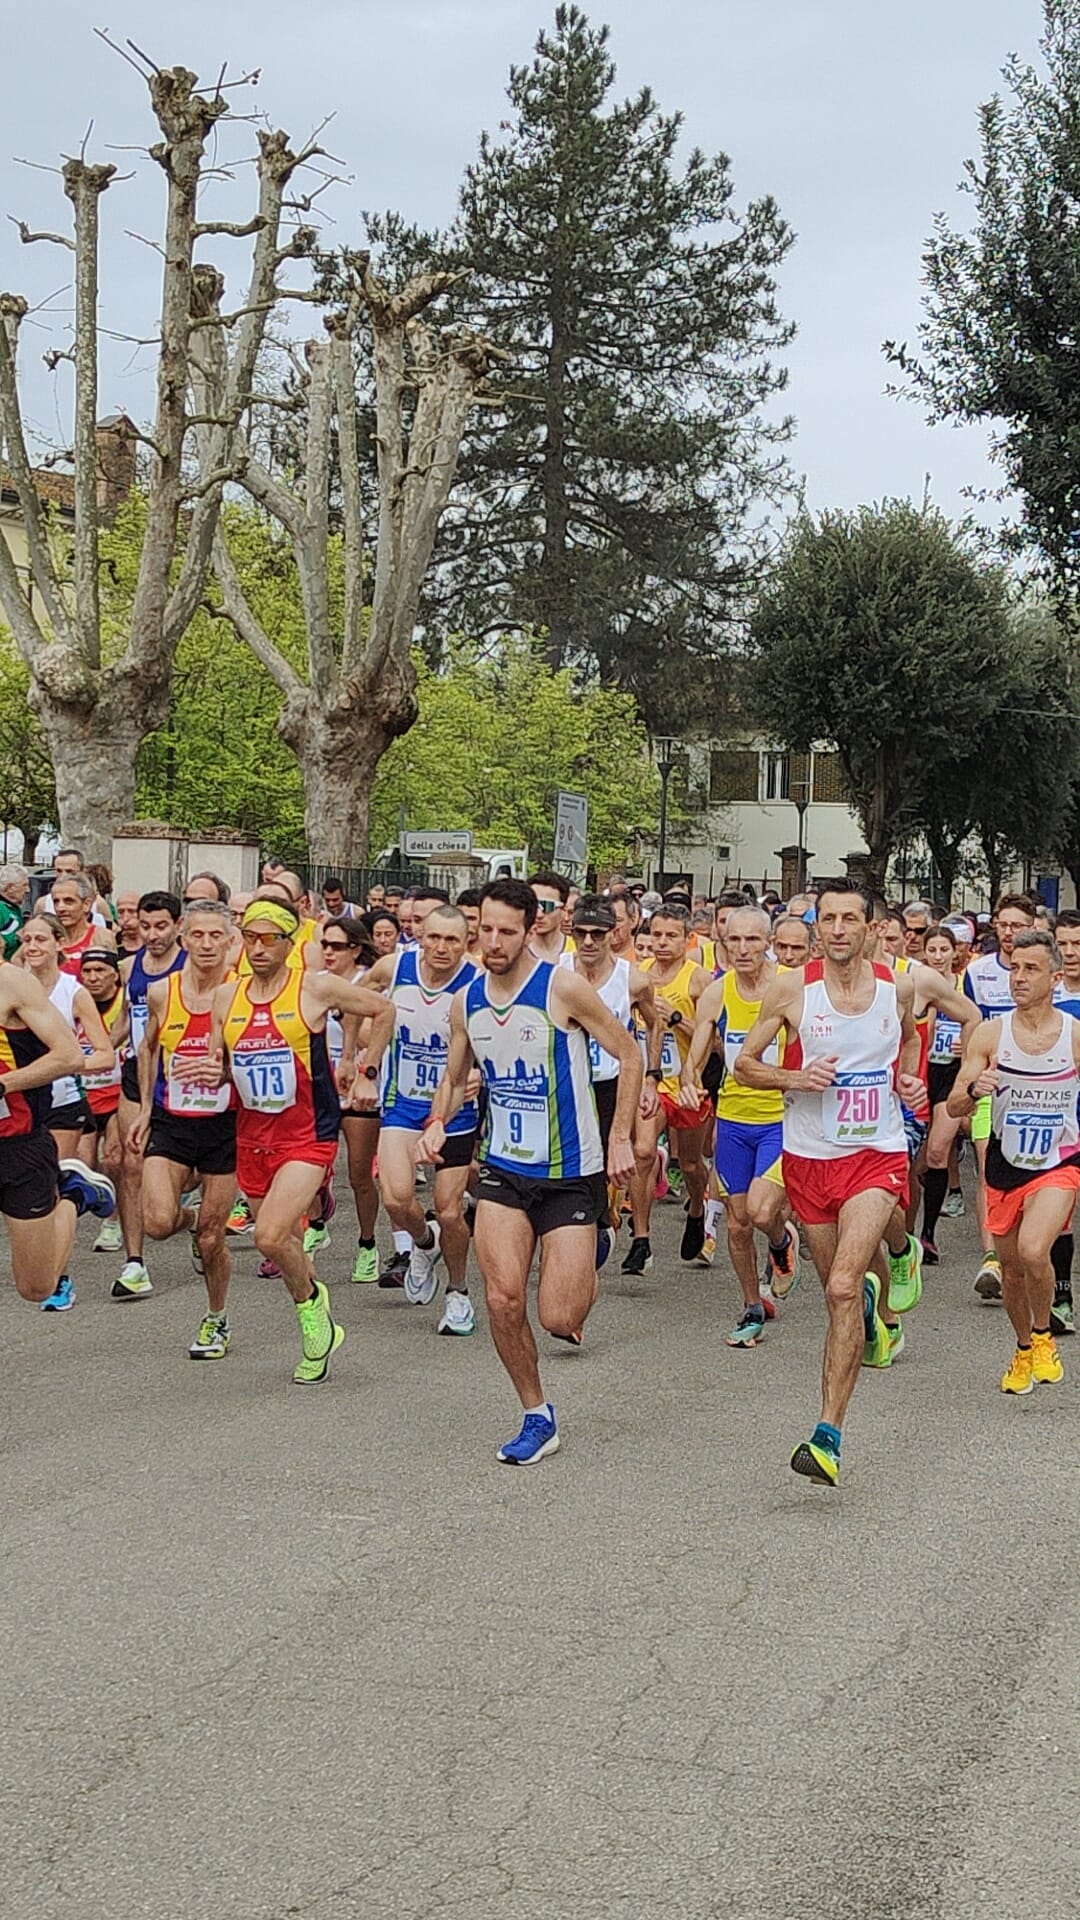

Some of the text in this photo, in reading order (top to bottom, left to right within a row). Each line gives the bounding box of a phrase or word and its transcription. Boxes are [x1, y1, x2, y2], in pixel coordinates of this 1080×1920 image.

[410, 841, 467, 850] della chiesa
[935, 1033, 953, 1053] 54
[246, 1066, 284, 1096] 173
[416, 1063, 438, 1088] 94
[849, 1074, 887, 1085] Mizuno
[505, 1099, 544, 1110] Mizuno
[837, 1088, 879, 1122] 250
[1011, 1089, 1071, 1100] NATIXIS
[510, 1112, 522, 1143] 9
[1019, 1128, 1052, 1154] 178
